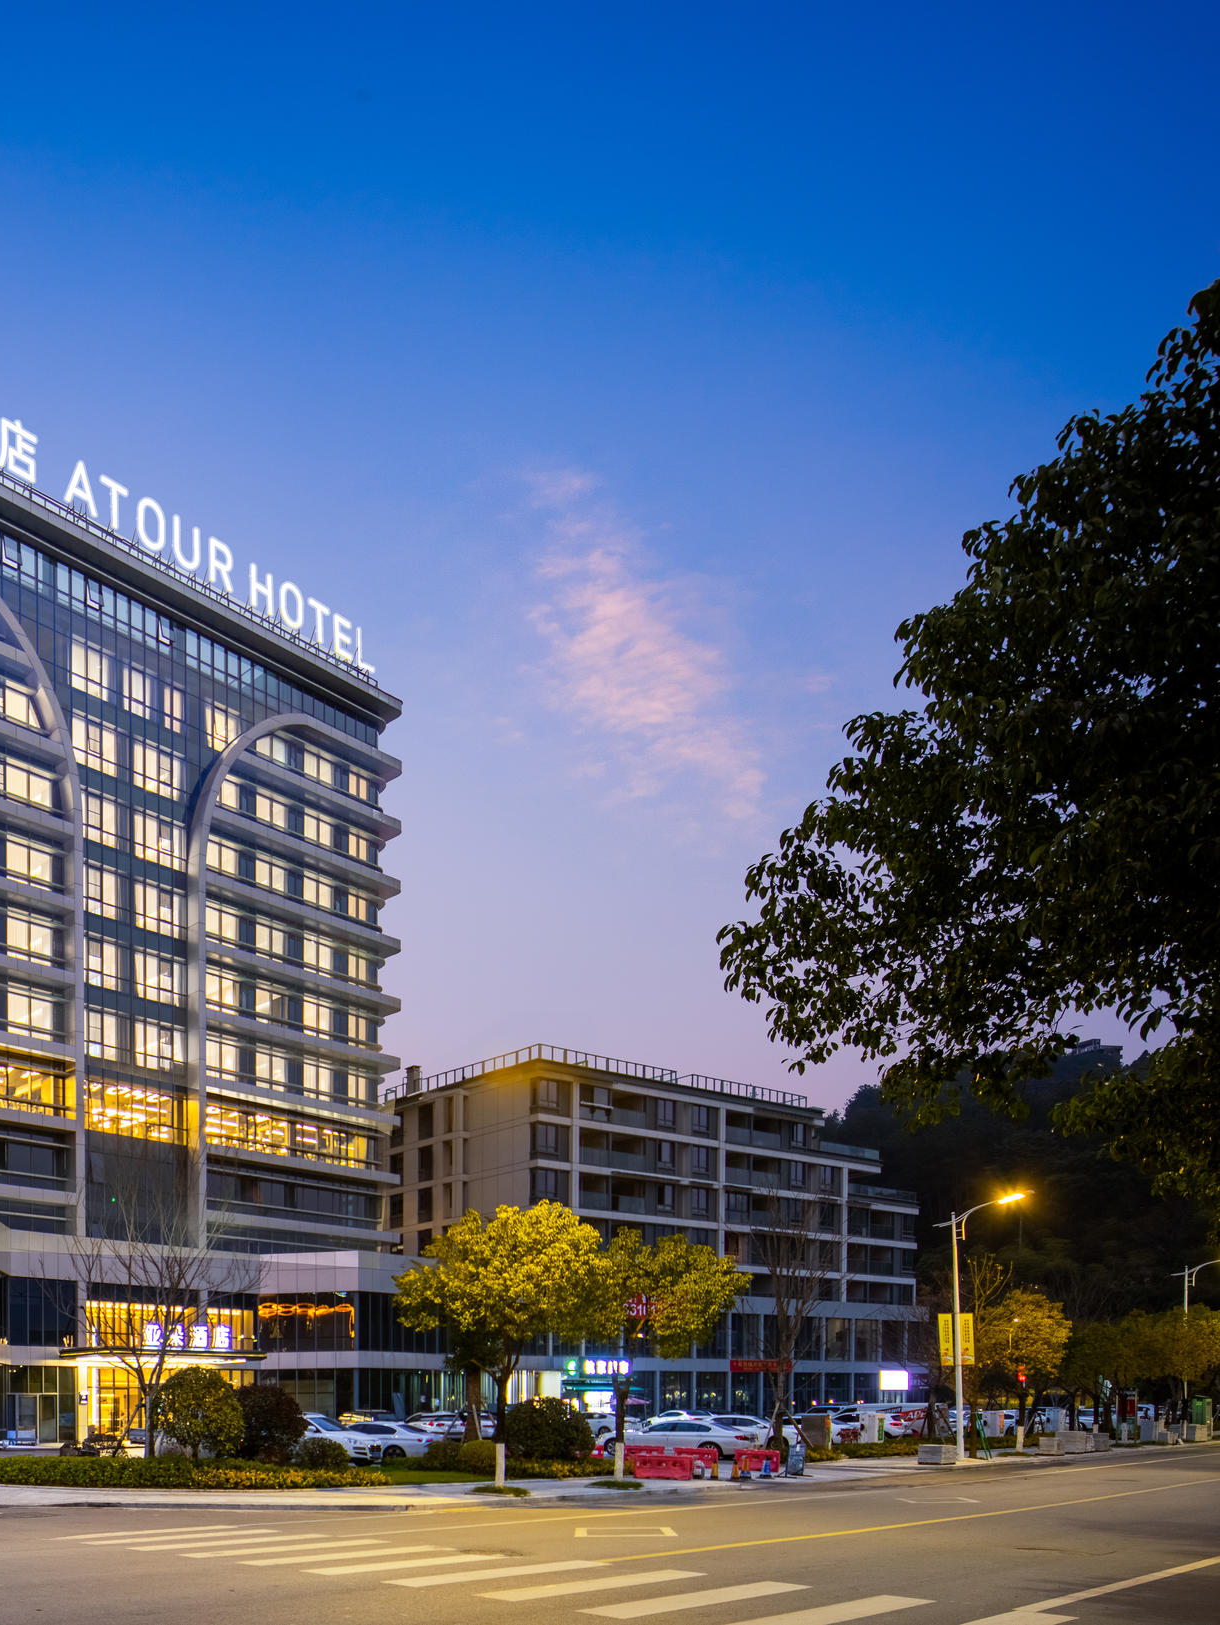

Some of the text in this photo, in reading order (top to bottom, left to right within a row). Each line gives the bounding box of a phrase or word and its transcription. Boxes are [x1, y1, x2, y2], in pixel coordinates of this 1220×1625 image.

[65, 460, 377, 673] ATOUR HOTEL
[142, 1323, 231, 1348] 亚朵酒店
